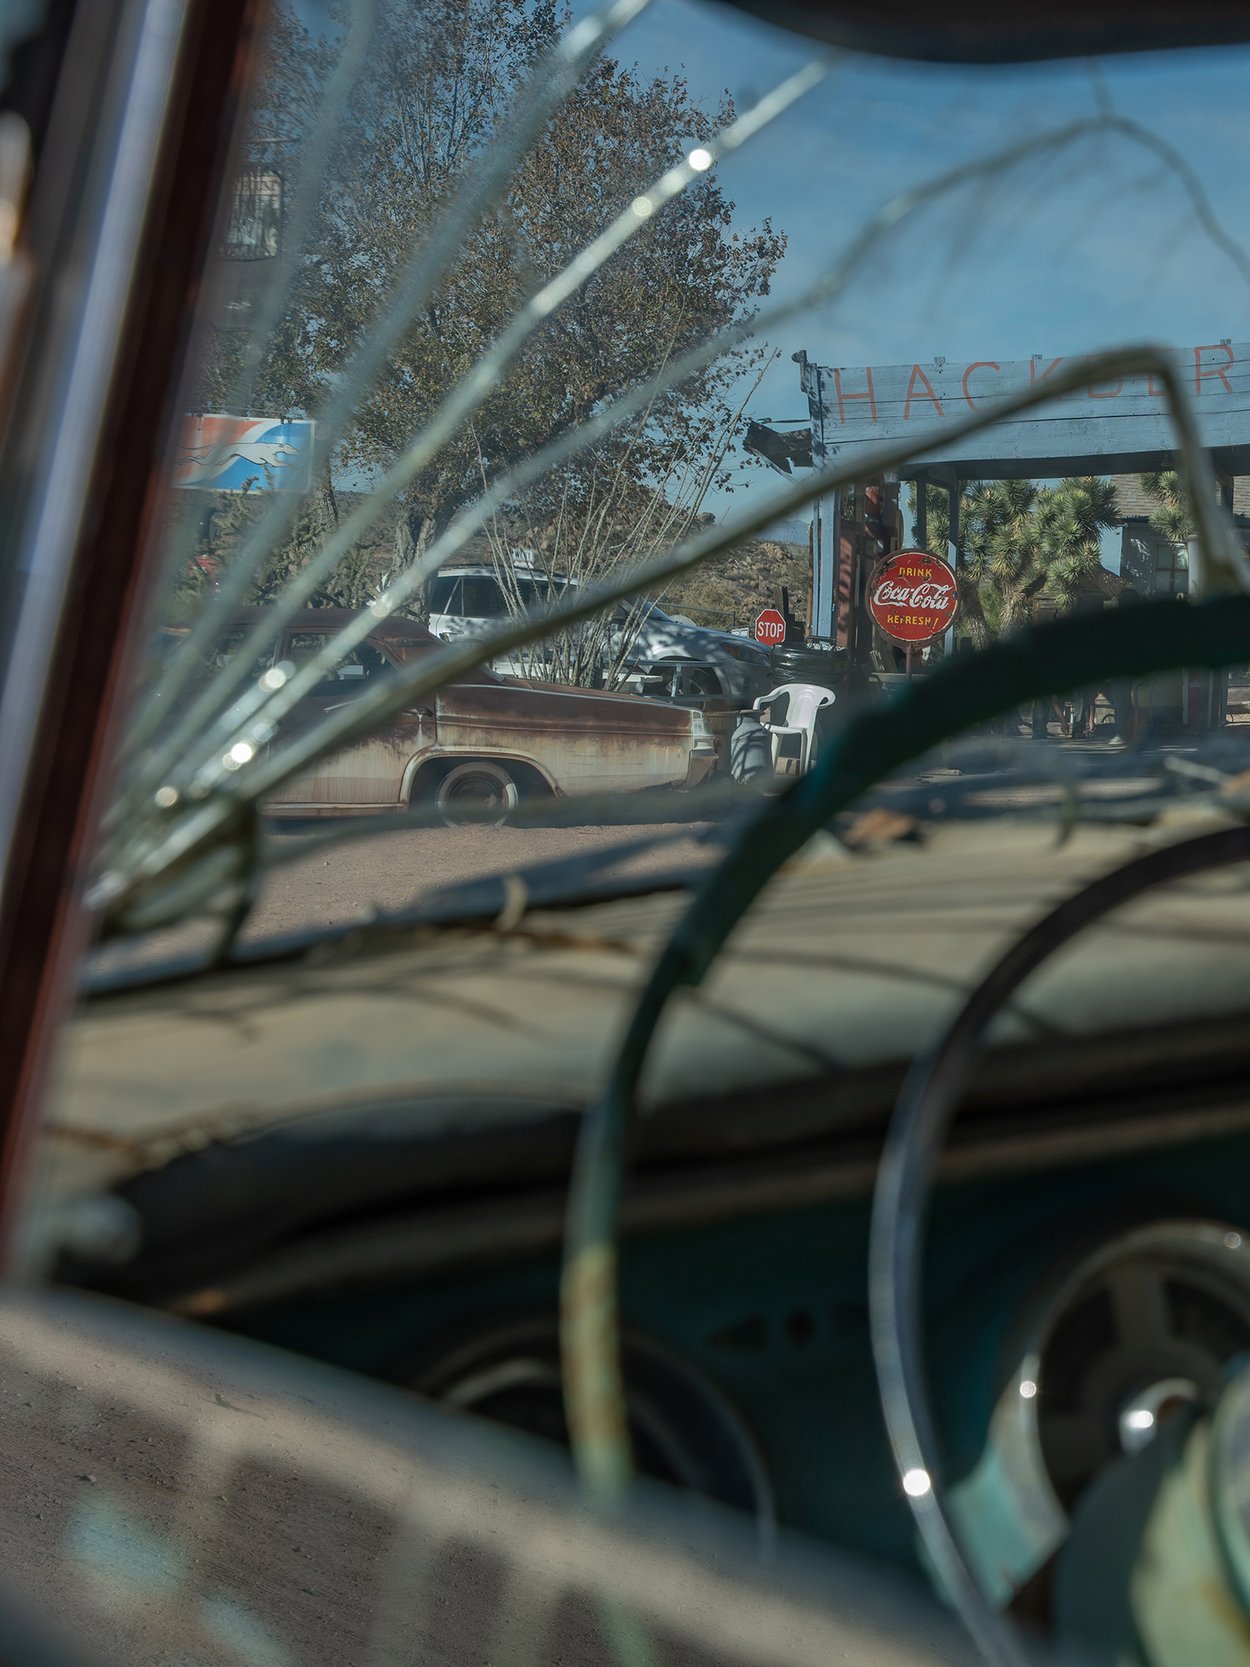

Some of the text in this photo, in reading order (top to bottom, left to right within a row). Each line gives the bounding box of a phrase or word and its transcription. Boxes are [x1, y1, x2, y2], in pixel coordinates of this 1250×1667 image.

[898, 566, 933, 577] DRINK
[873, 580, 954, 610] Coca-Cola
[757, 621, 784, 638] STOP
